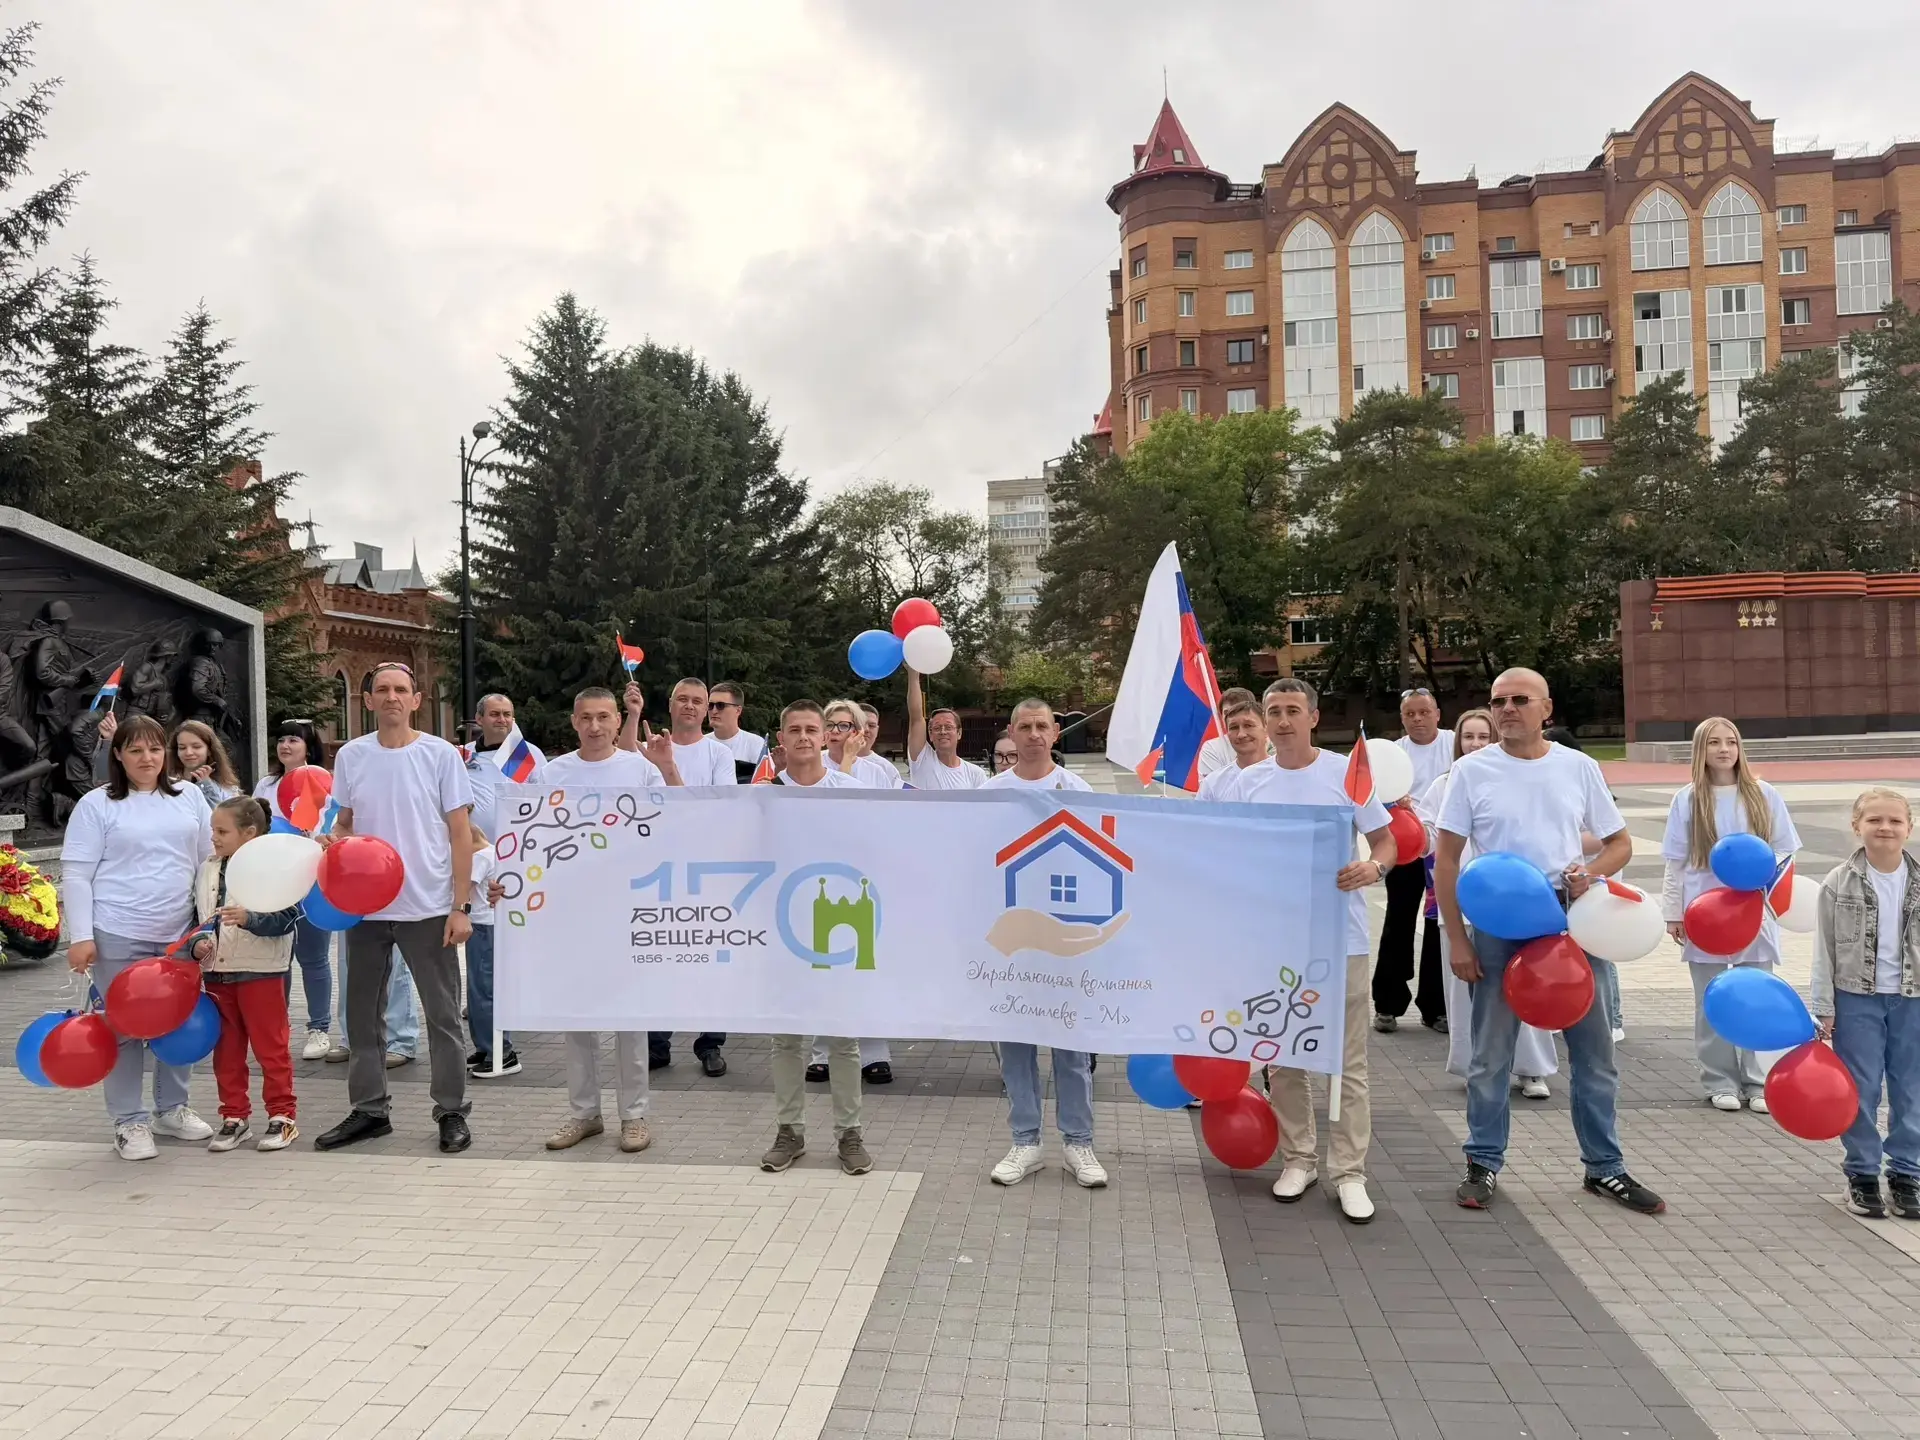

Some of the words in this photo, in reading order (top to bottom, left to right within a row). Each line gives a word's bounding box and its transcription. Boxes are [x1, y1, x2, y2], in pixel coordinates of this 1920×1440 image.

[630, 861, 882, 966] 170
[630, 906, 732, 924] БЛАГО
[631, 929, 767, 947] ВЕЩЕНСК
[631, 954, 663, 964] 1856
[675, 953, 710, 964] 2026
[966, 960, 1075, 988] Управляющая
[1080, 969, 1153, 997] компания
[989, 994, 1078, 1030] «Комплекс
[1099, 1004, 1131, 1025] М»
